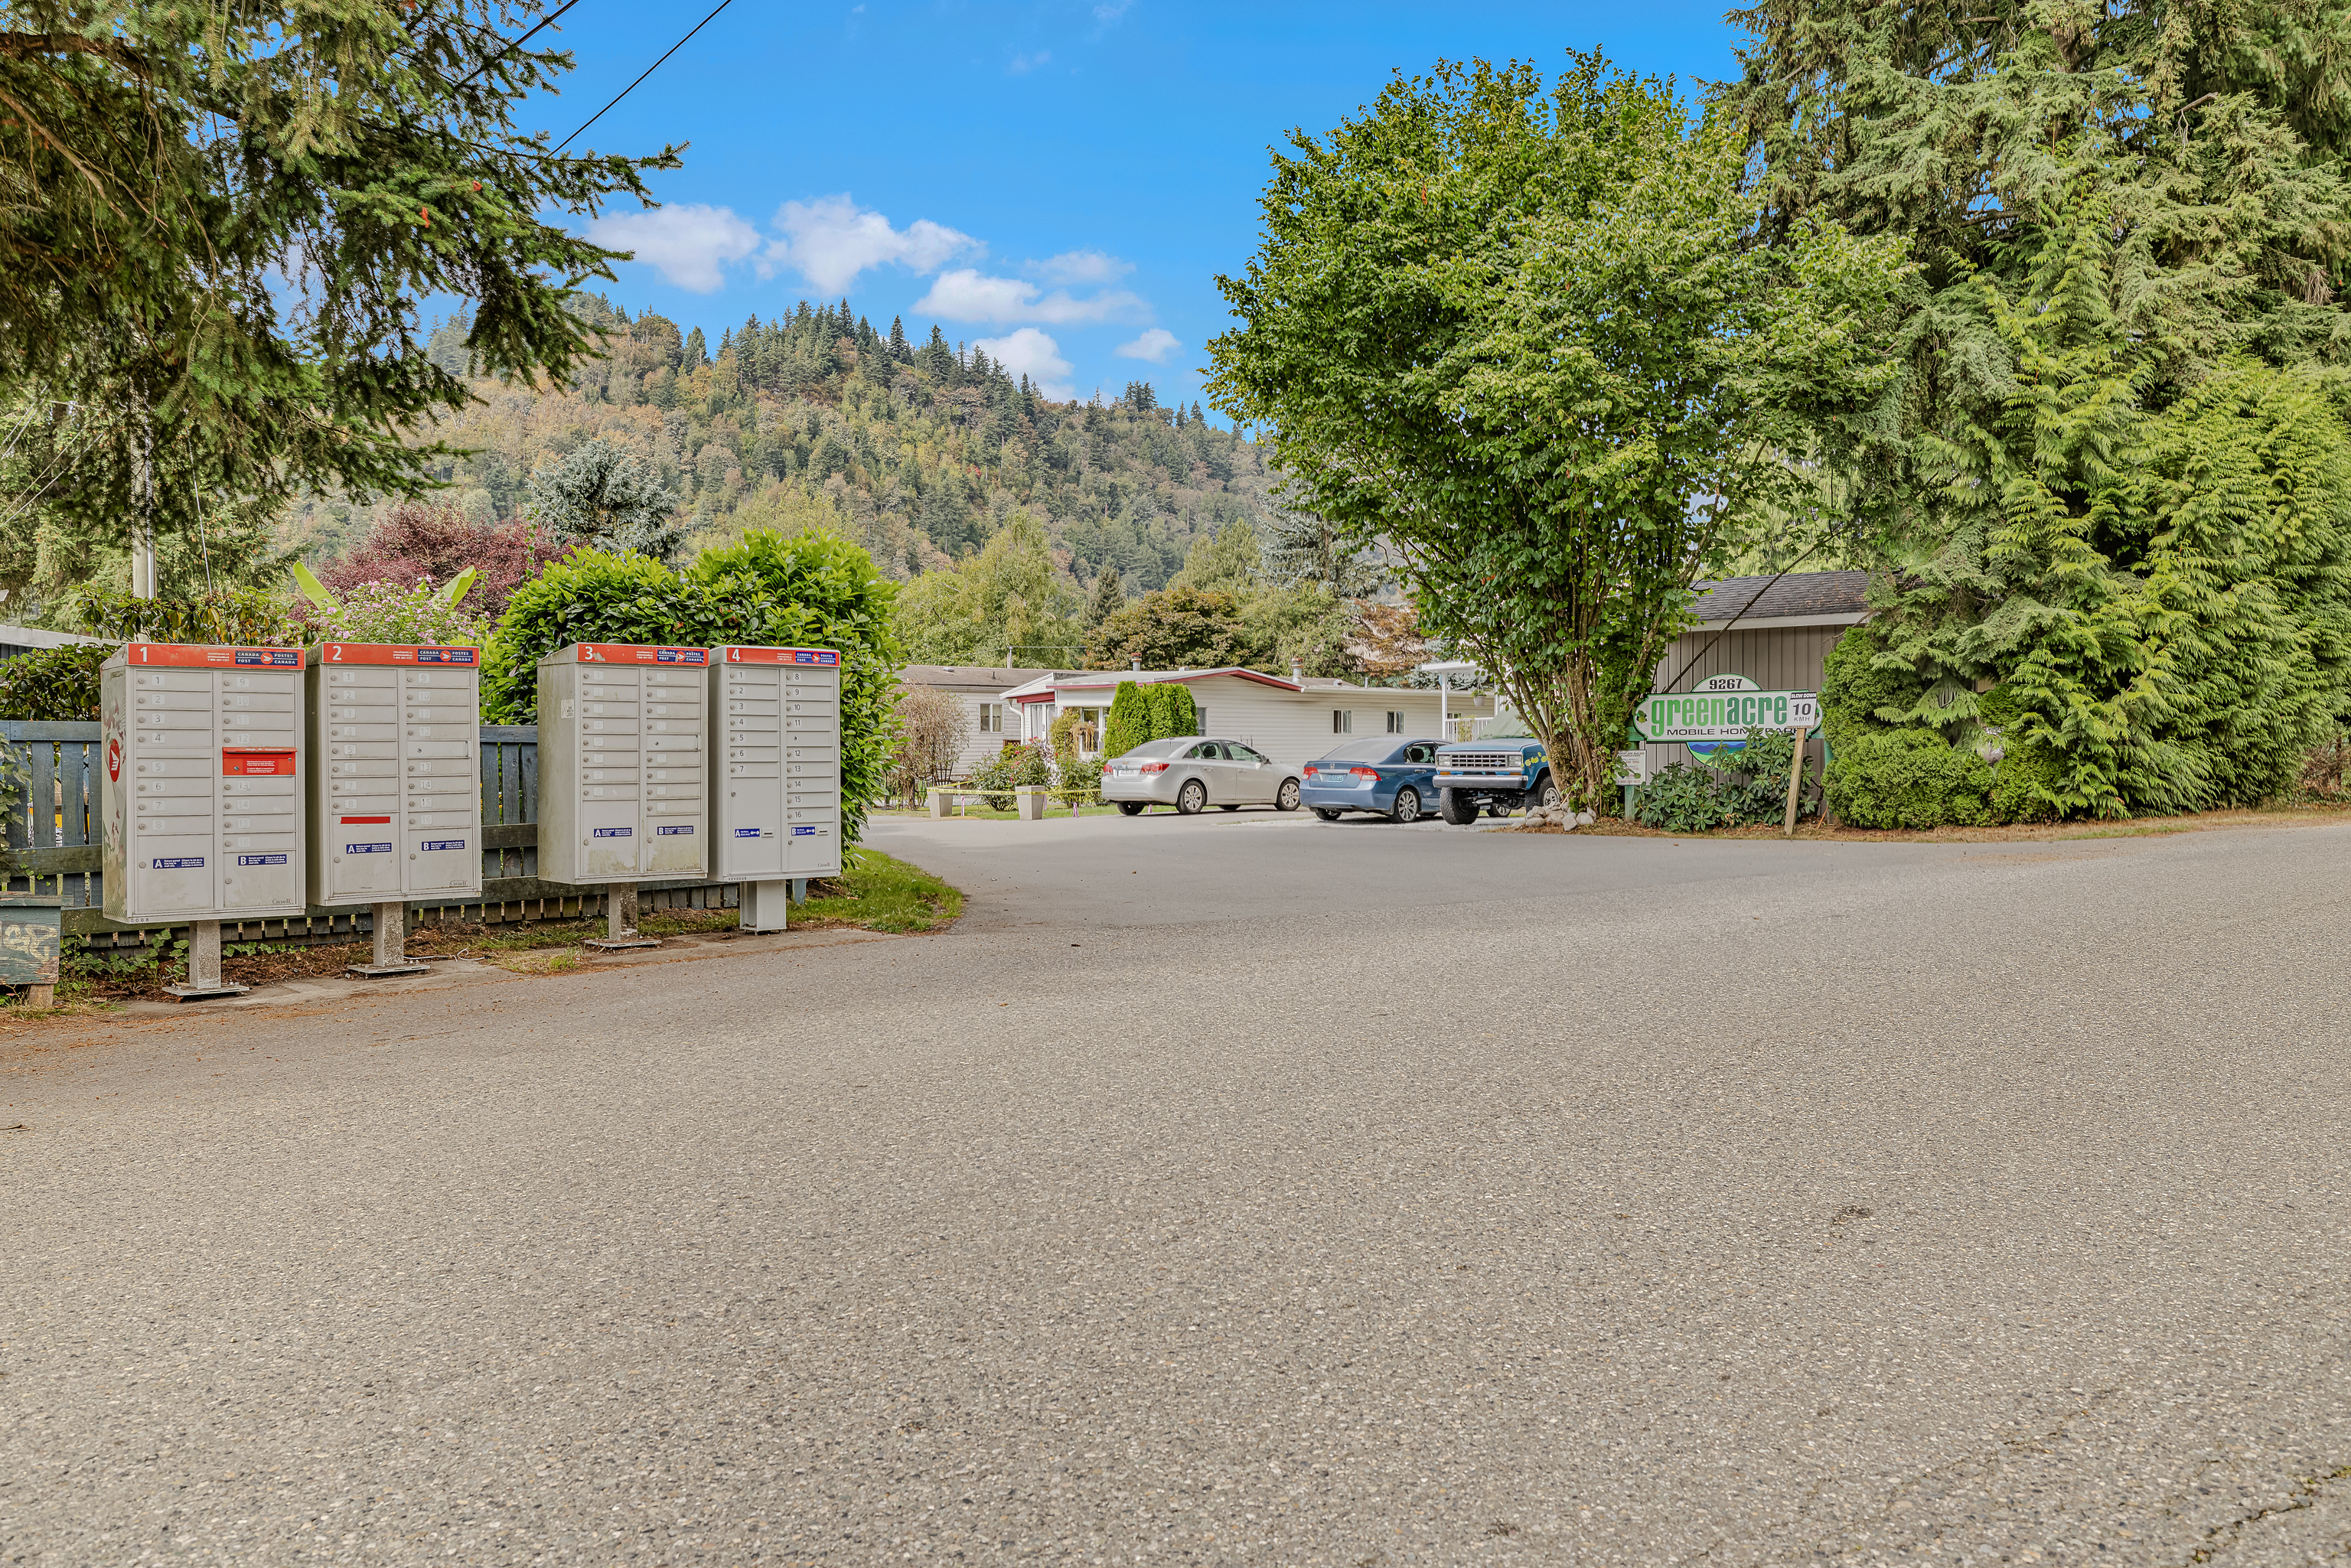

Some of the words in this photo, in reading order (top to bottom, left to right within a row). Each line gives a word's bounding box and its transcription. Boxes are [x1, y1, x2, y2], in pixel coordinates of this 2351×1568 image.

[140, 647, 147, 662] 1
[333, 645, 342, 660] 2
[585, 646, 593, 660] 3
[732, 648, 741, 661] 4
[421, 674, 426, 683] 9
[1709, 679, 1743, 689] 9267
[155, 695, 161, 703] 2
[346, 691, 351, 699] 2
[1792, 703, 1811, 716] 10
[155, 734, 161, 742] 4
[347, 745, 353, 754] 5
[155, 763, 161, 771] 5
[155, 782, 161, 791] 6
[422, 781, 430, 789] 14
[155, 801, 161, 810] 7
[348, 800, 354, 808] 8
[595, 829, 602, 837] A
[347, 845, 355, 853] A
[155, 859, 163, 869] A
[240, 856, 246, 865] B
